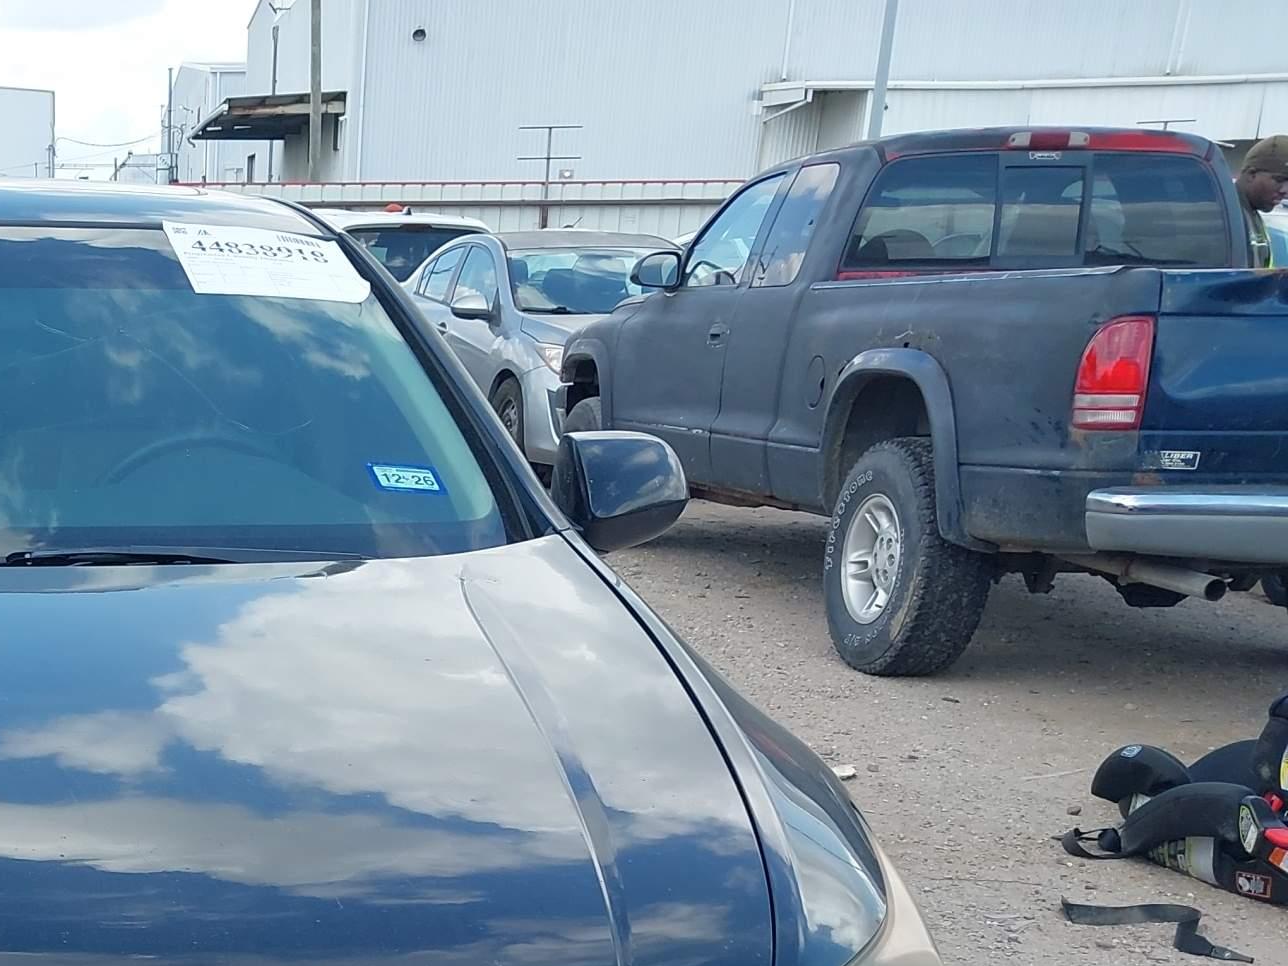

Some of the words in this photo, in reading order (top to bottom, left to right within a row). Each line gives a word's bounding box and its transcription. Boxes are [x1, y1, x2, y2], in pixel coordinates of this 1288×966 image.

[190, 238, 329, 264] 44838918
[381, 473, 405, 484] 12
[411, 474, 435, 487] 26
